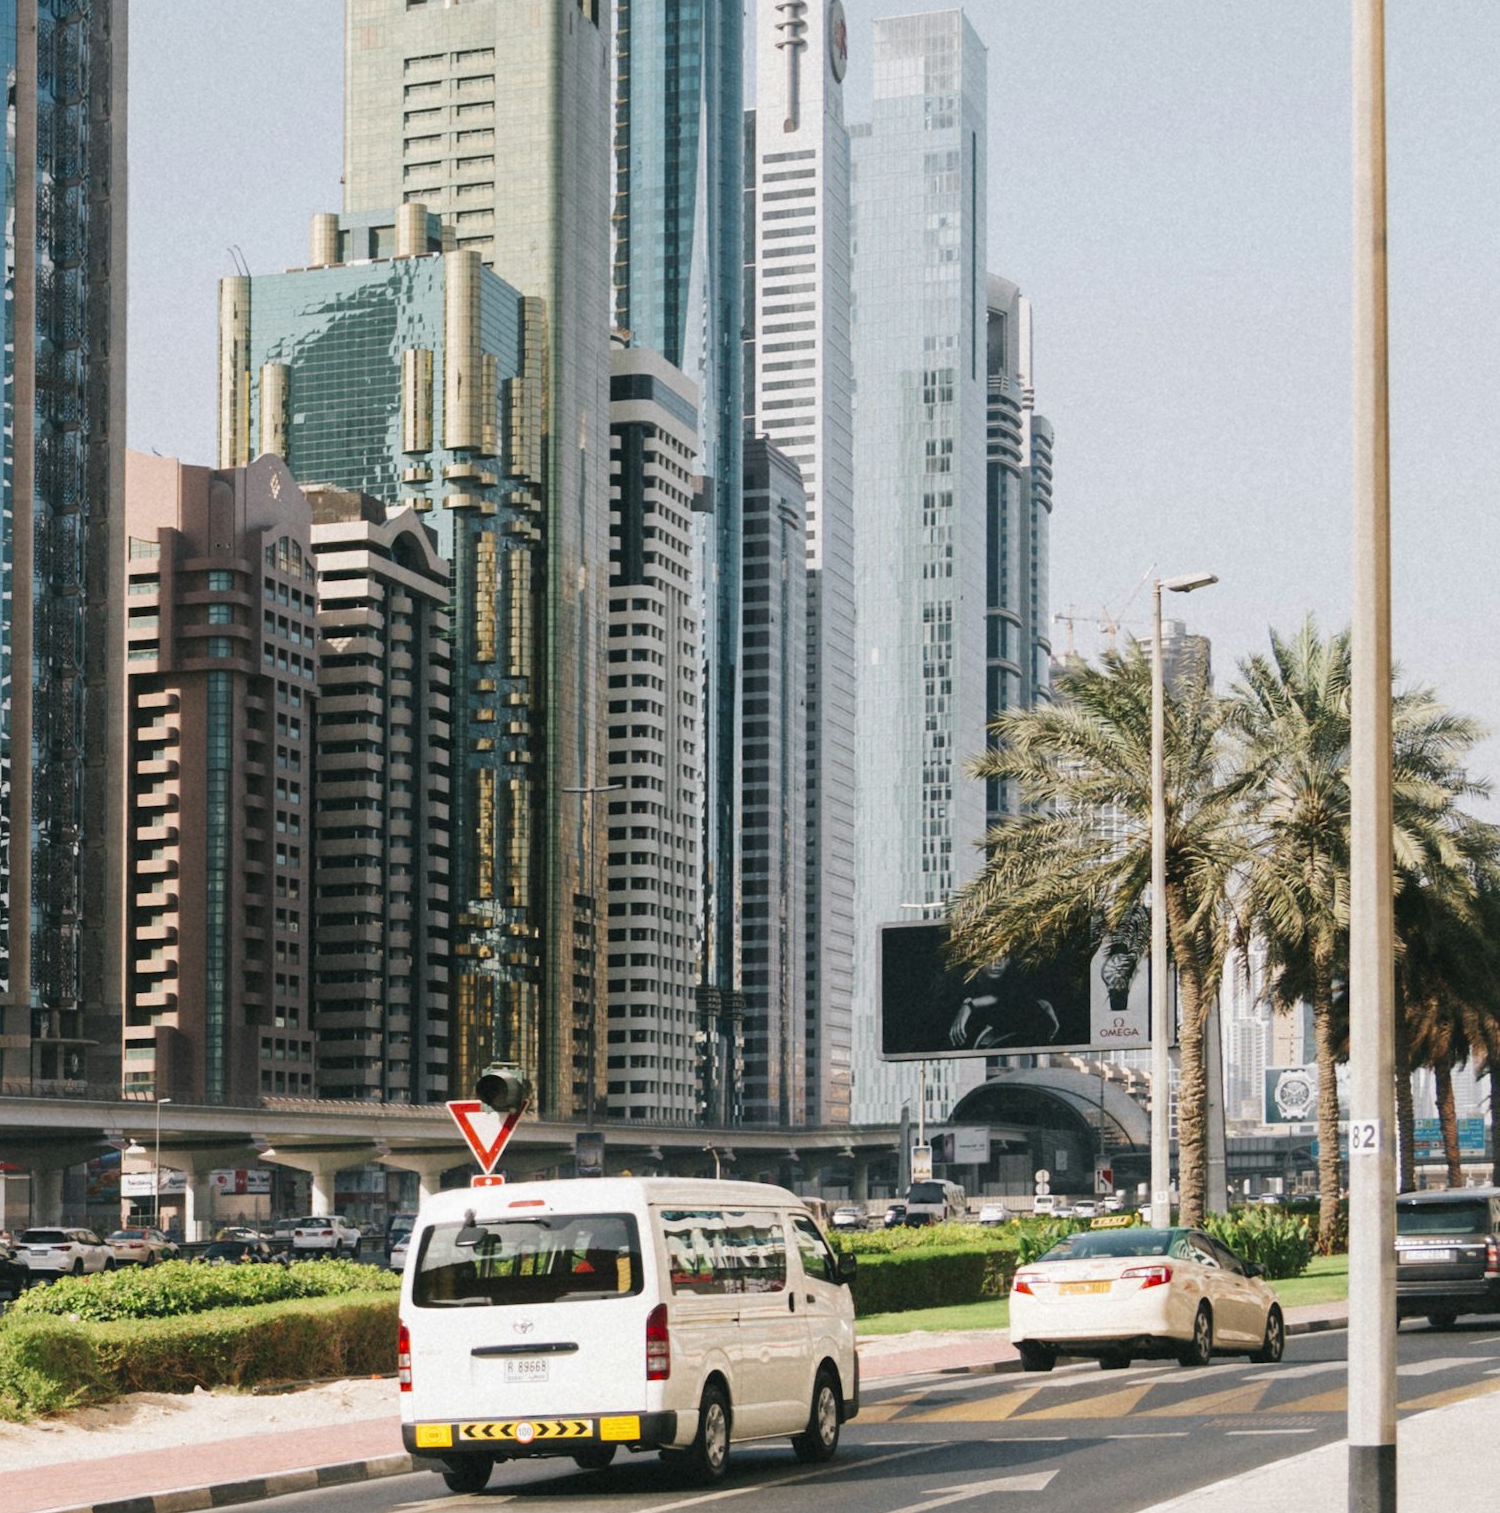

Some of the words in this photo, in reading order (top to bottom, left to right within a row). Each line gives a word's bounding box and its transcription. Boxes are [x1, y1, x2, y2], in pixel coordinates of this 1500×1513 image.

[1100, 1027, 1139, 1038] OMEGA
[1352, 1124, 1375, 1149] 82
[519, 1426, 532, 1437] 100
